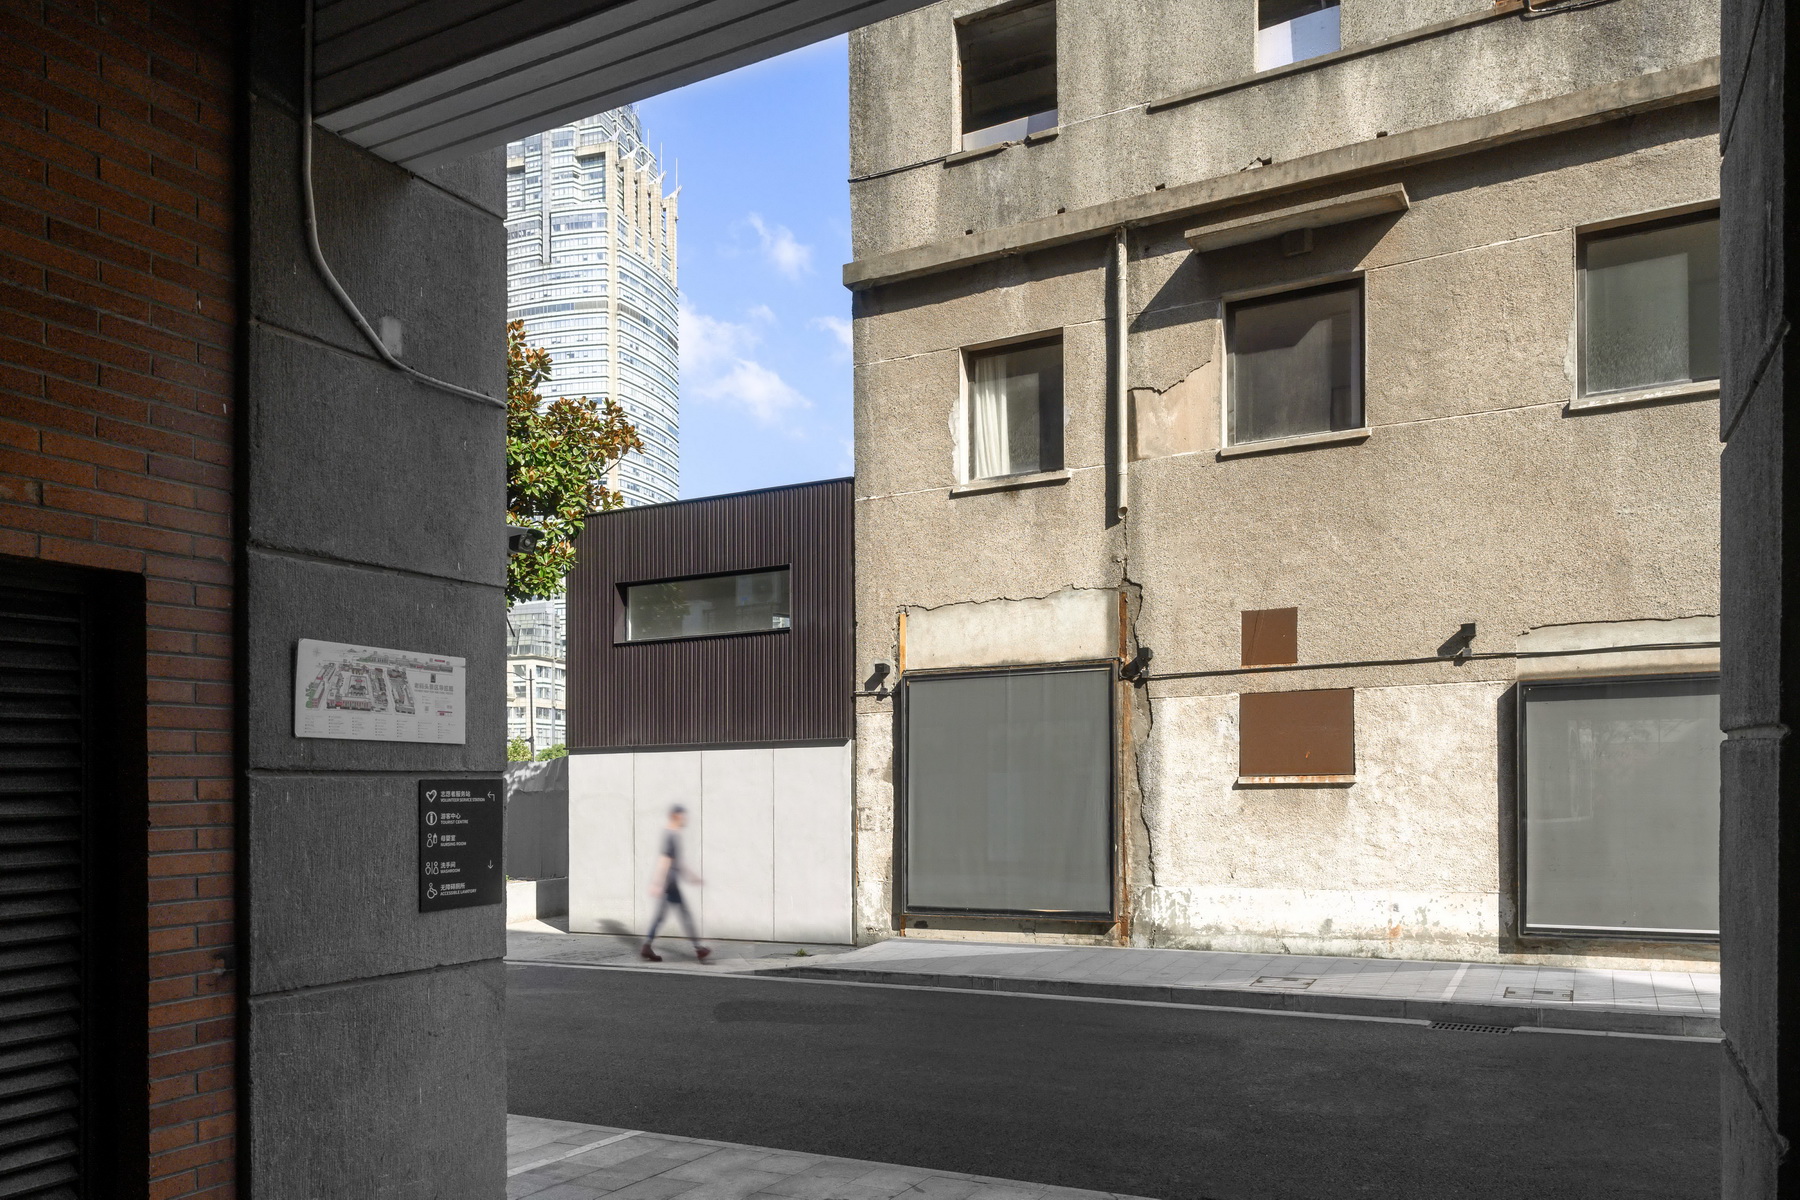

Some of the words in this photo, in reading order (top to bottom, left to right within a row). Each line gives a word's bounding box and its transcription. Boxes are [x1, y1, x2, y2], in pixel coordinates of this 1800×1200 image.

[440, 812, 461, 820] 游客中心
[440, 834, 456, 842] 母婴室
[440, 861, 456, 869] 洗手间
[440, 882, 466, 891] 无障碍厕所
